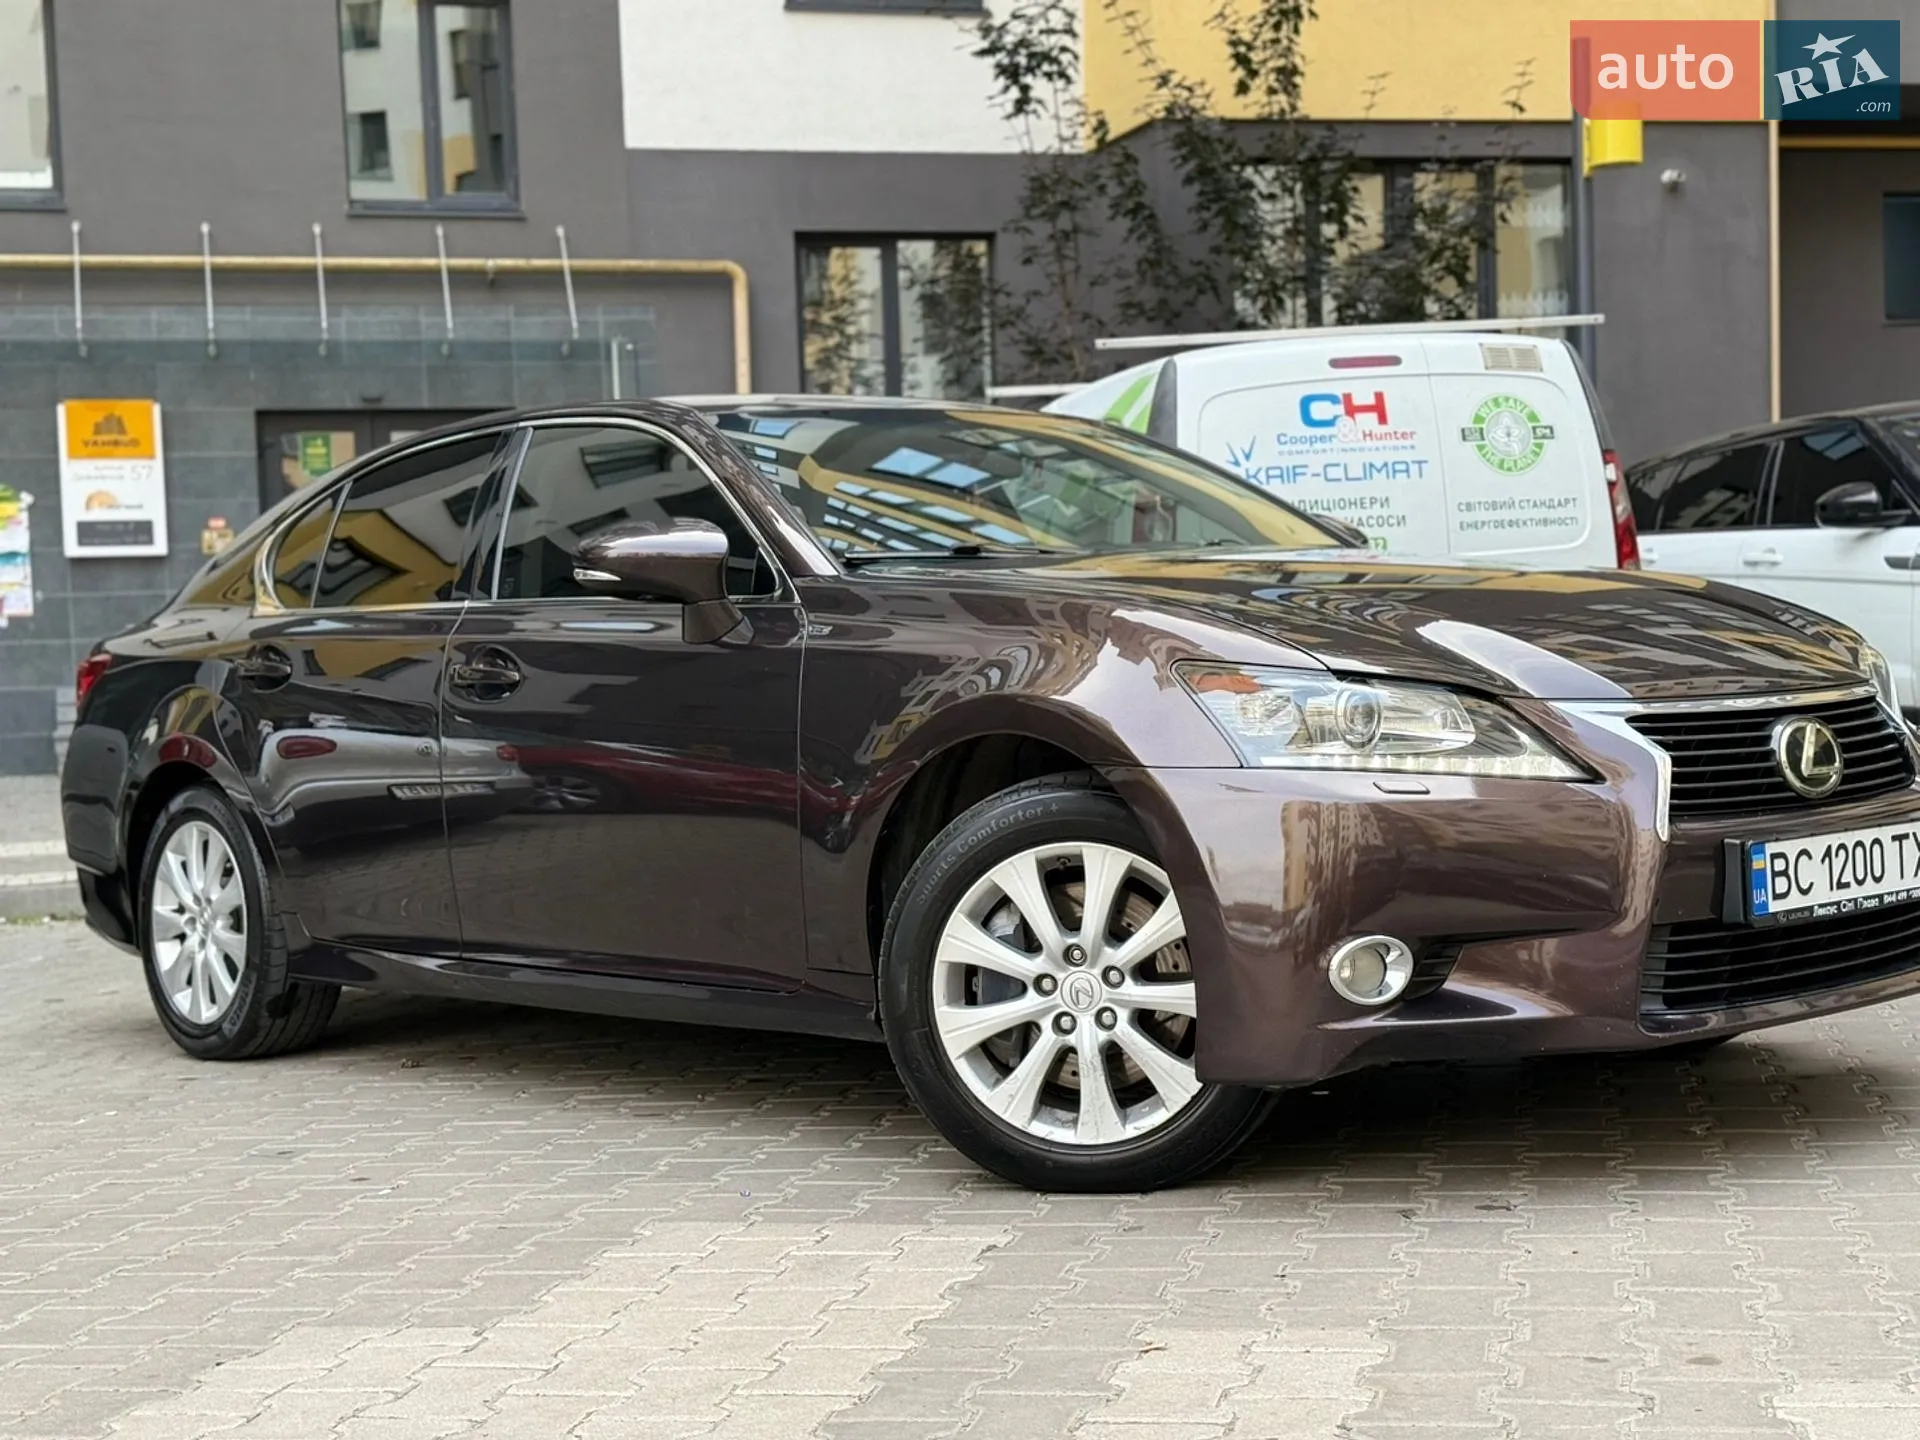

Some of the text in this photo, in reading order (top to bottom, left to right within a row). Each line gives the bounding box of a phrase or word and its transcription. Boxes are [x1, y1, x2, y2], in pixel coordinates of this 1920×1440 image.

[1276, 431, 1337, 446] Cooper
[1361, 429, 1417, 442] Hunter
[1245, 460, 1429, 486] KAIF-CLIMAT
[1291, 495, 1390, 513] ДИЦІОНЕРИ
[1457, 497, 1578, 512] СВІТОВИЙ СТАНДАРТ
[957, 805, 1043, 854] Comforter
[1769, 848, 1814, 901] BC
[1820, 837, 1886, 892] 1200
[1753, 890, 1767, 904] UA
